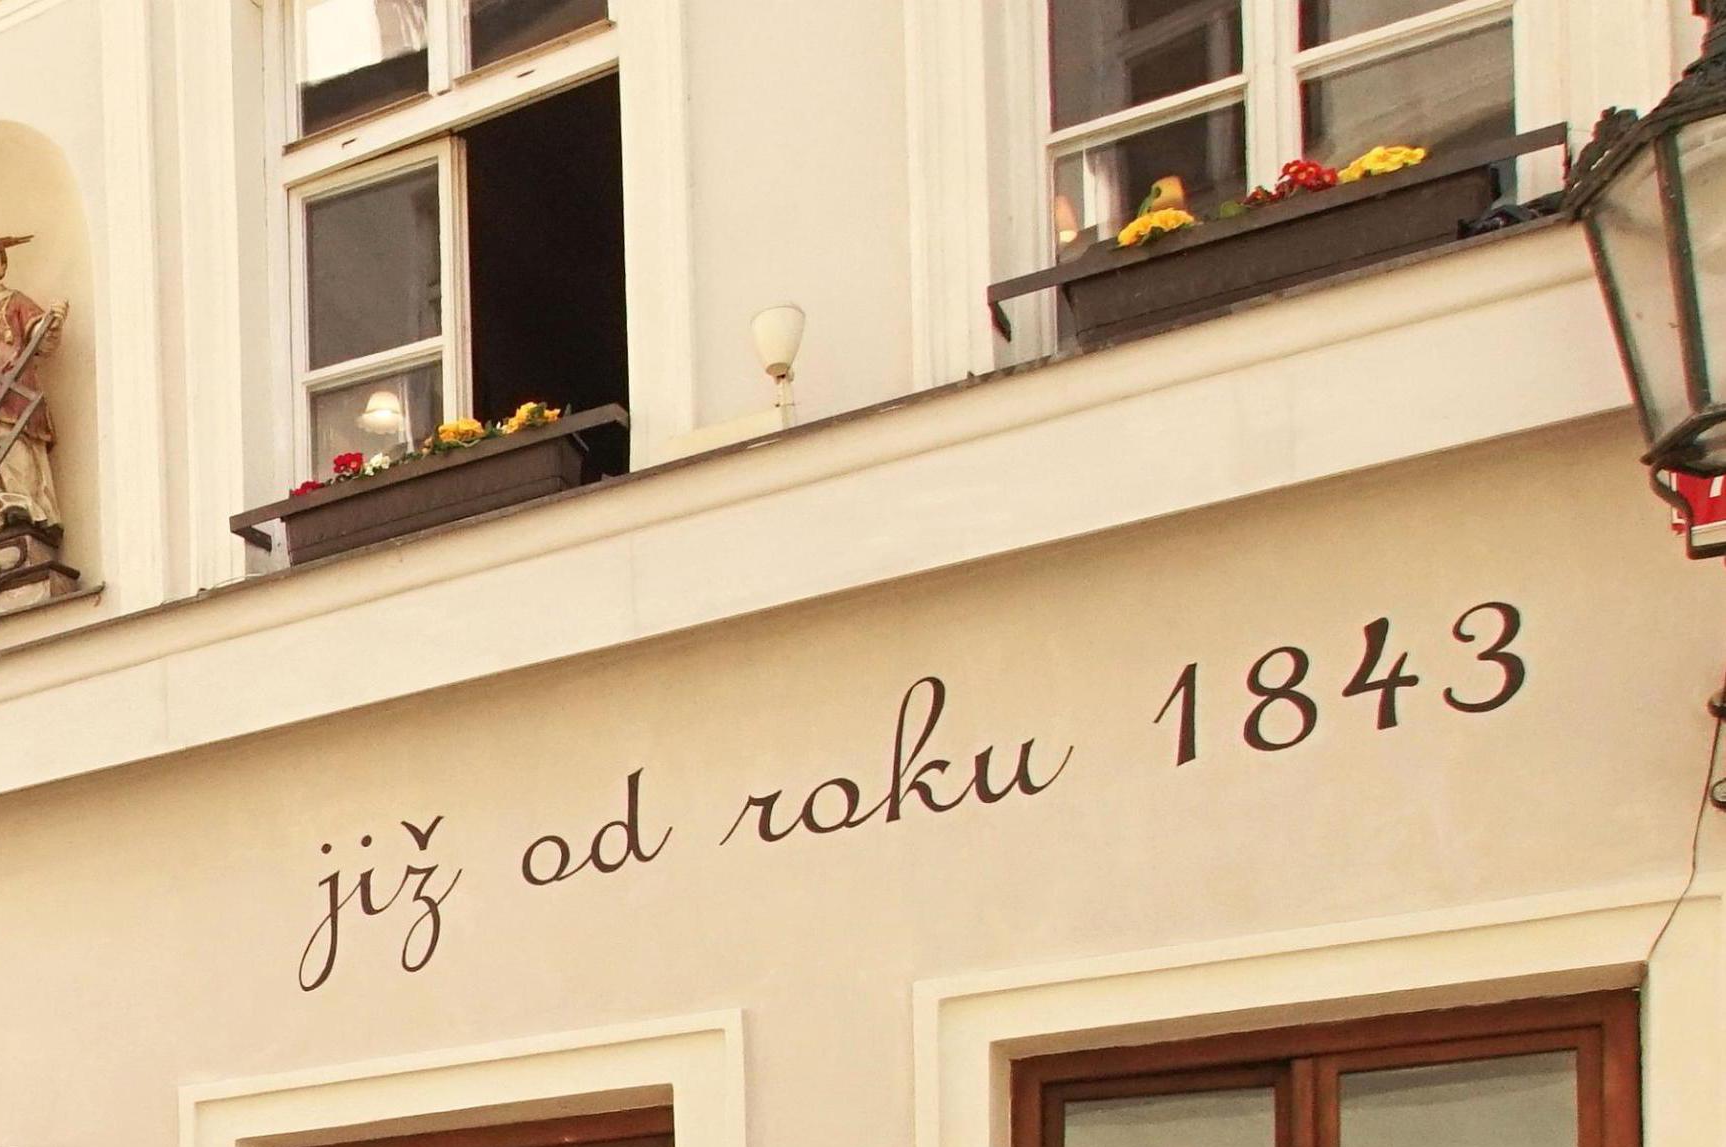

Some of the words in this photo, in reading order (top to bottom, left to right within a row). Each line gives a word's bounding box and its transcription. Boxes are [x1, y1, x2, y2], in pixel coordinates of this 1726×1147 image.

[298, 815, 463, 992] již
[522, 768, 672, 886] od
[720, 676, 1074, 847] roku
[1153, 600, 1527, 768] 1843
